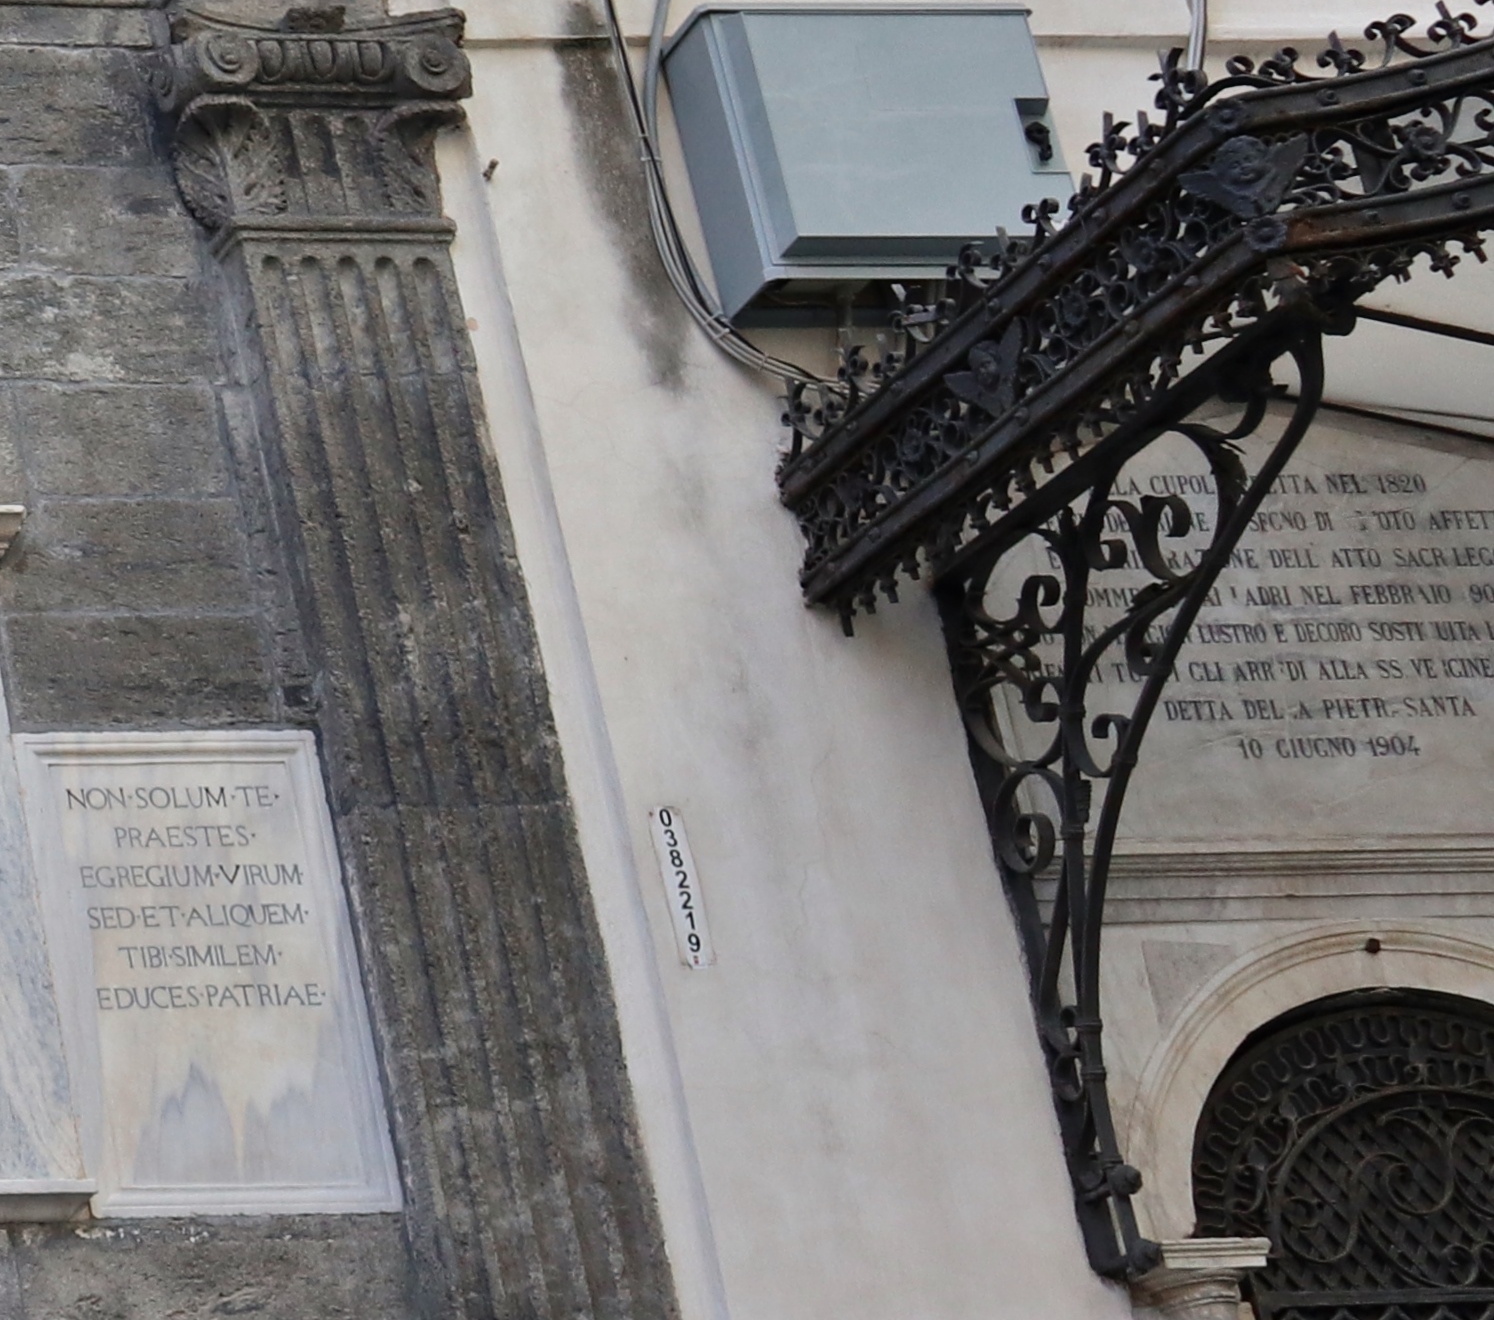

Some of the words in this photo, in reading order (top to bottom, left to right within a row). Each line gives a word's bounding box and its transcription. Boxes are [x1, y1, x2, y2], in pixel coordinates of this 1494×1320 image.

[1149, 476, 1216, 496] CUPOL
[1325, 474, 1368, 495] NEL
[1376, 473, 1428, 495] 1820
[1331, 547, 1382, 568] ATTO
[1299, 584, 1343, 606] NEL
[1196, 622, 1267, 644] LUSTRO
[1296, 622, 1363, 643] DECORO
[1319, 659, 1370, 680] ALLA
[1163, 699, 1234, 721] DETTA
[1237, 738, 1264, 760] 10
[1275, 737, 1357, 759] GIUGNO
[1366, 735, 1422, 758] 1904
[65, 787, 126, 810] NON
[134, 787, 228, 810] SOLUM
[234, 785, 276, 808] TE
[114, 825, 250, 848] PRAESTES
[80, 865, 215, 888] EGREGIUM
[217, 864, 302, 886] VIRUM
[658, 808, 701, 953] 0382219
[87, 906, 137, 930] SED
[142, 906, 181, 928] ET
[186, 903, 307, 927] ALIQUEM
[118, 946, 169, 969] TIBI
[171, 944, 279, 968] SIMILEM
[96, 985, 200, 1010] EDUCES
[205, 983, 323, 1007] PATRIAE
